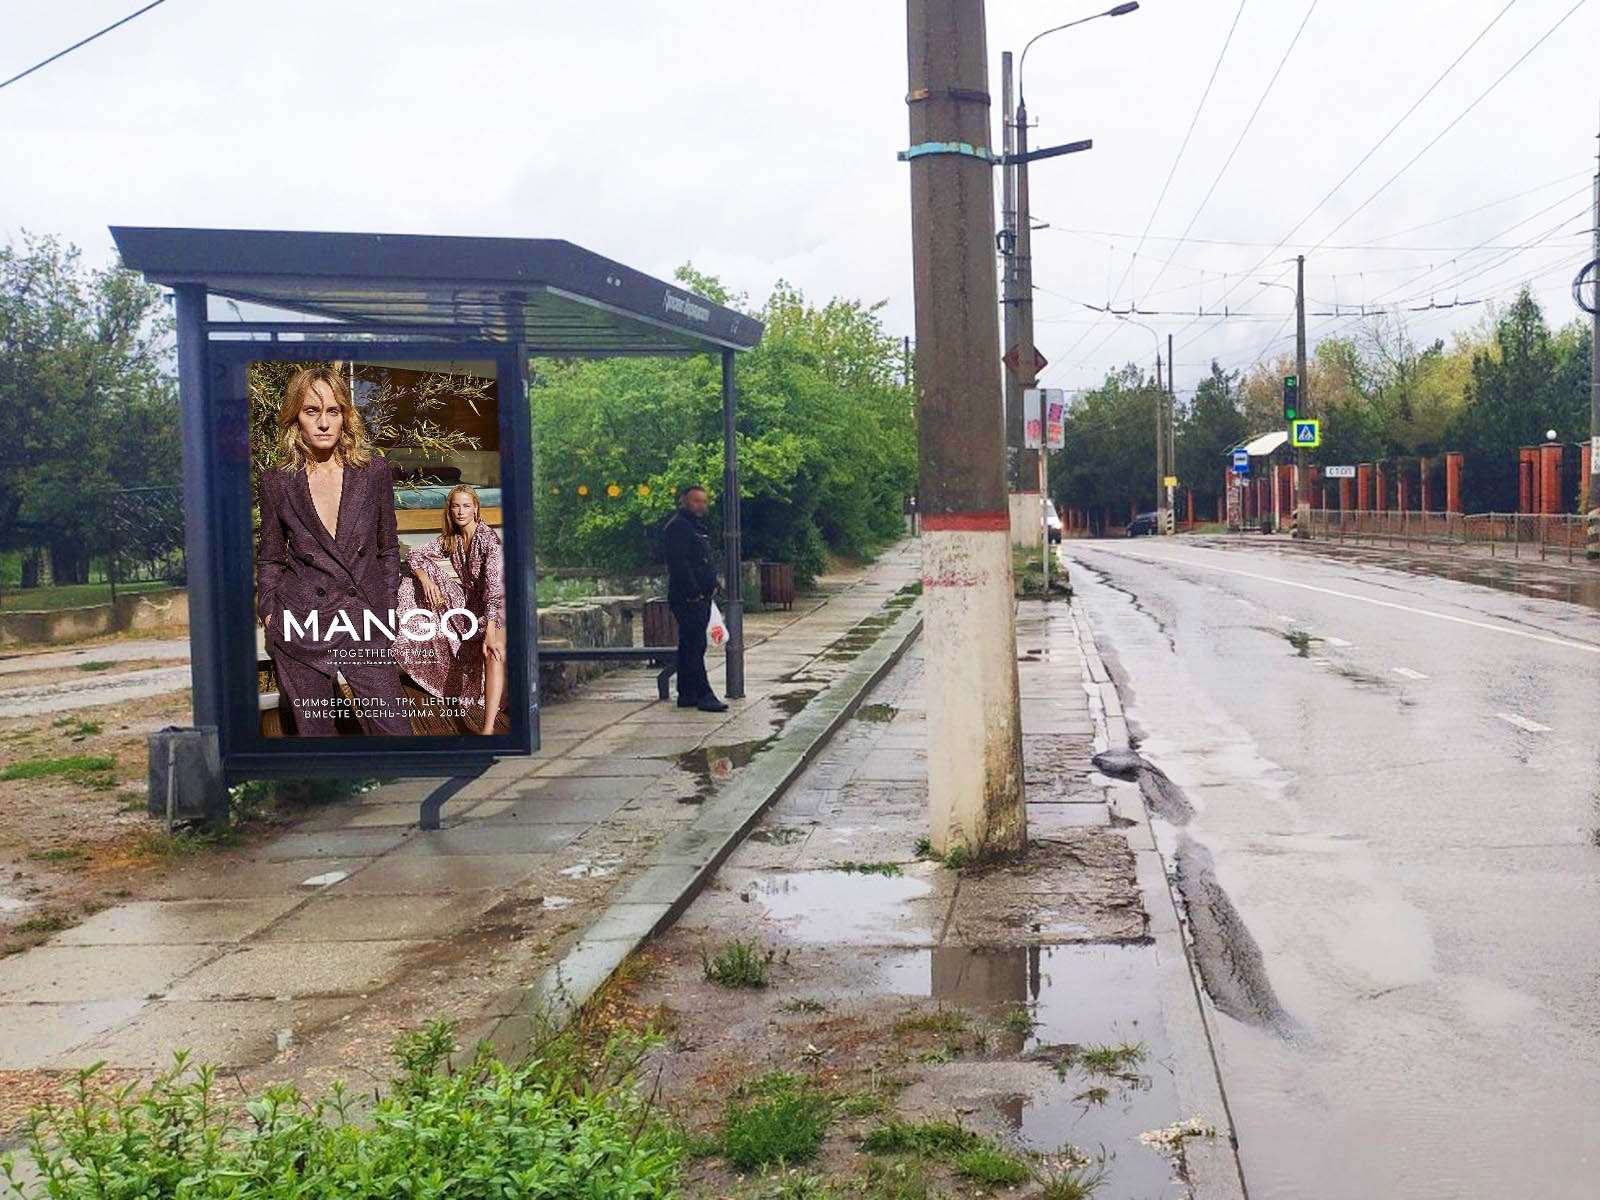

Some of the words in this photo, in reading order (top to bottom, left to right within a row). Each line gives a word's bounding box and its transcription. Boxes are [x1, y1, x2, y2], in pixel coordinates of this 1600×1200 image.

[283, 608, 479, 642] MANGO
[293, 697, 390, 707] СИМФЕРОПОЛЬ,
[395, 697, 416, 707] ТРК
[422, 696, 474, 706] ЦЕНТРУМ
[355, 709, 434, 718] ОСЕНЬ-ЗИМА
